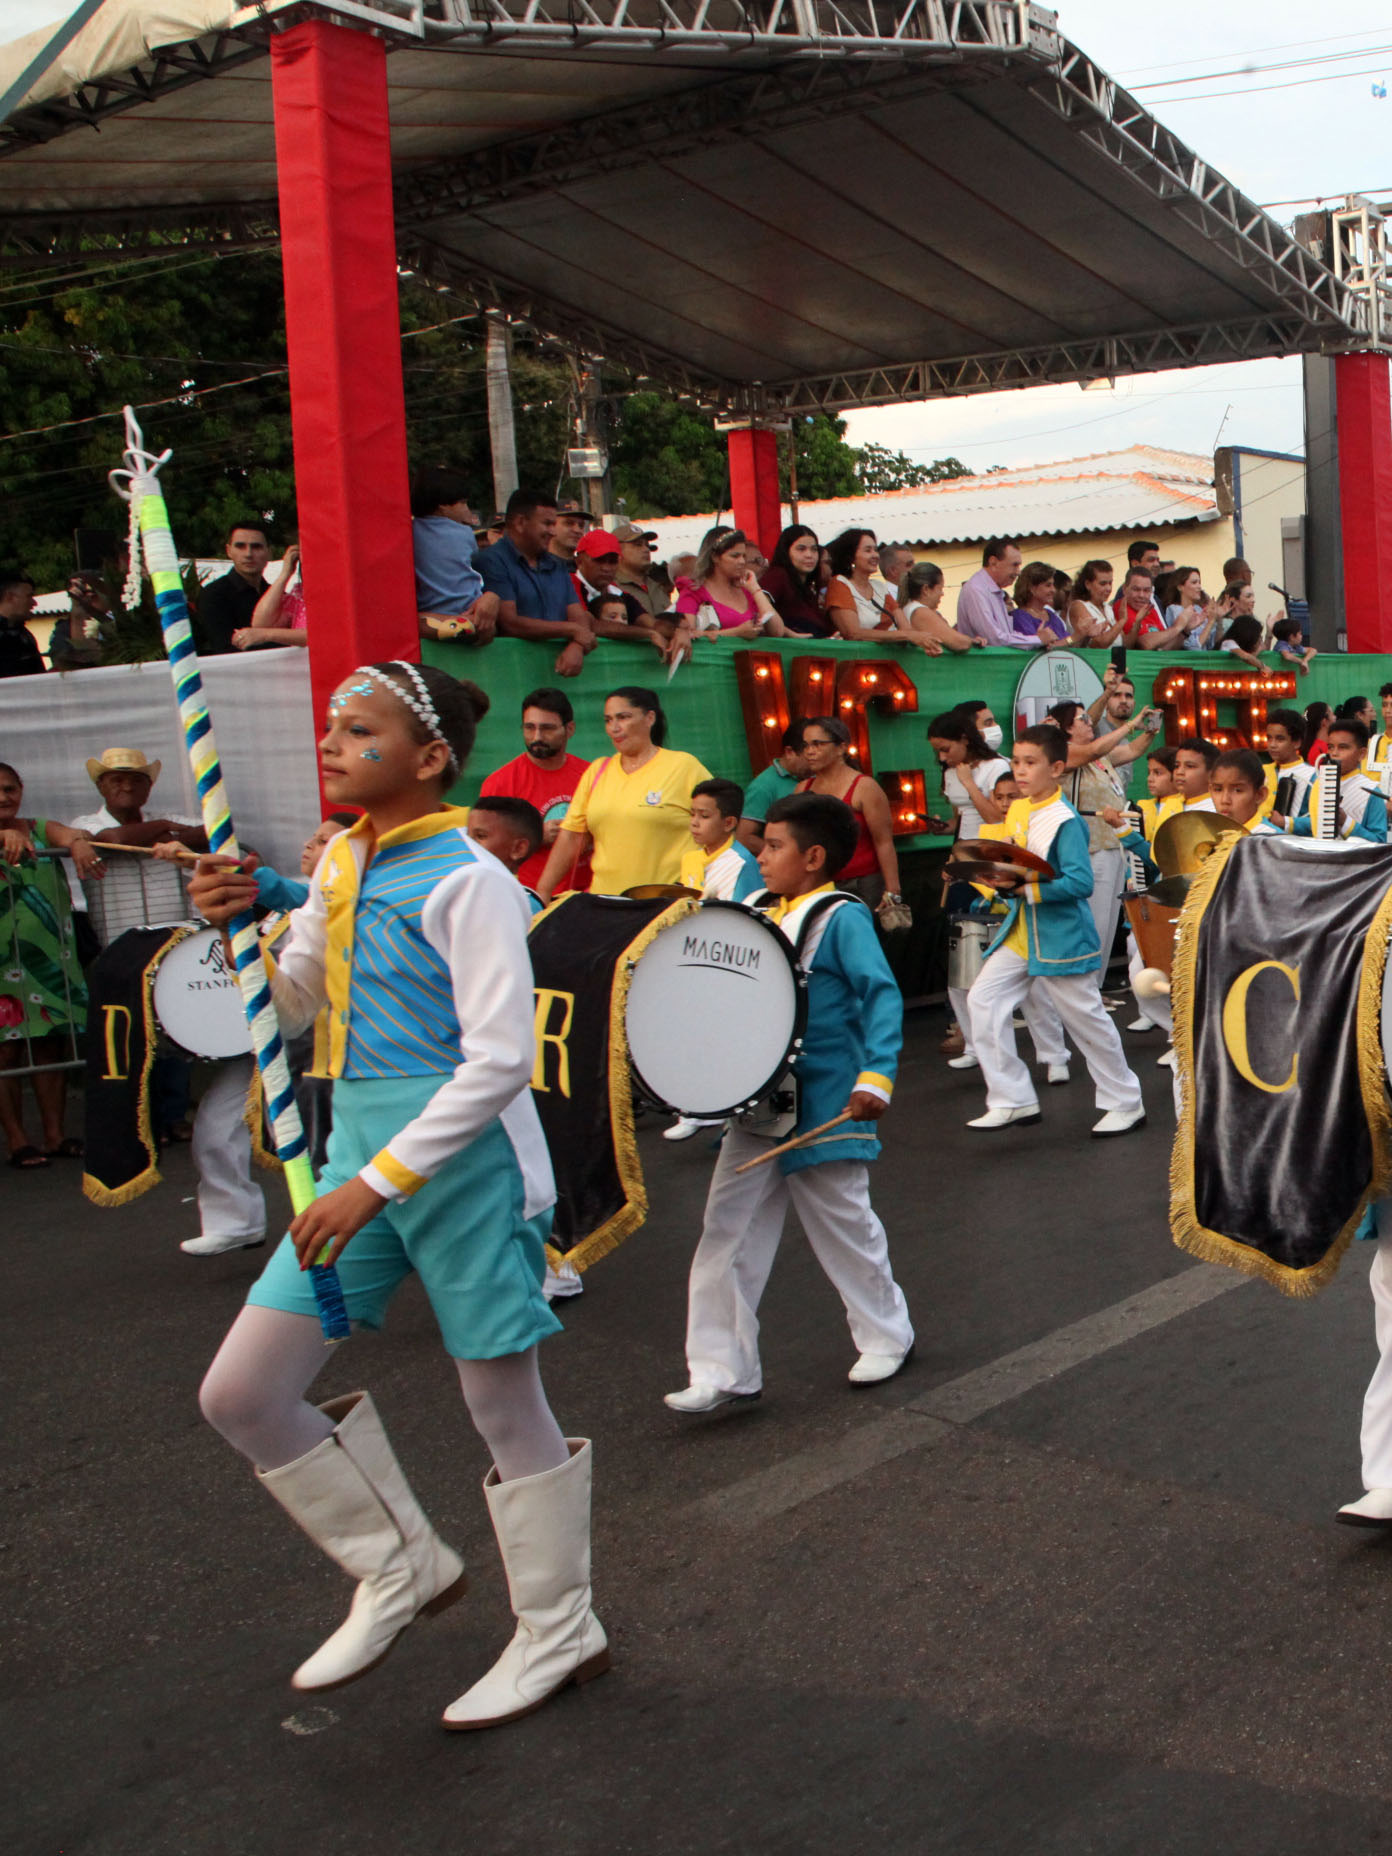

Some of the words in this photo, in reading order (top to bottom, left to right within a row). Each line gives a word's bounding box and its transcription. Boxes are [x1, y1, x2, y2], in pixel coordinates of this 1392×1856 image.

[682, 935, 761, 969] MAGNUM
[529, 987, 575, 1100] R
[1222, 960, 1301, 1094] C
